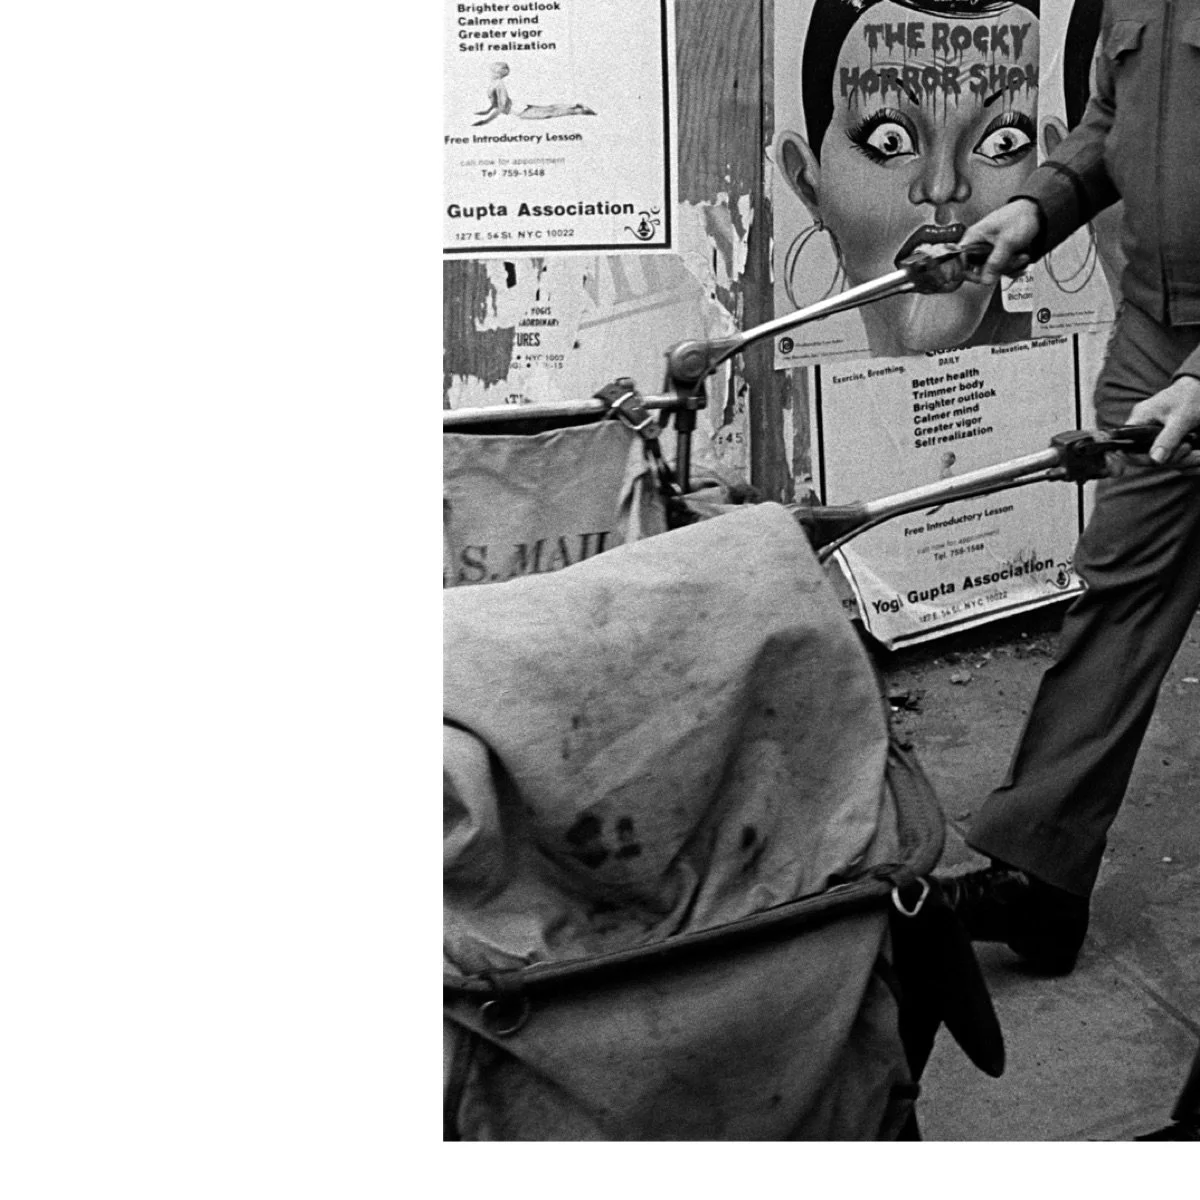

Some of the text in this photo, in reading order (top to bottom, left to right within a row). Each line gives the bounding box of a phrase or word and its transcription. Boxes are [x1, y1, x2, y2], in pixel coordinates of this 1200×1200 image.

[457, 1, 561, 14] Brighter outlook
[458, 15, 539, 26] Calmer mind
[458, 28, 543, 39] Greater vigor
[864, 22, 1032, 60] THE ROCKY
[459, 41, 556, 52] Self realization
[840, 65, 960, 98] HORROR
[444, 133, 583, 144] Free Introductory Lesson
[501, 169, 545, 178] 759-1548
[446, 201, 635, 220] Gupta Association
[518, 230, 543, 239] NYC
[546, 229, 575, 237] 10022
[938, 356, 960, 366] DAILY
[832, 371, 866, 384] Exercise,
[912, 367, 980, 388] Better health
[912, 378, 984, 400] Trimmer body
[913, 388, 997, 413] Brighter outlook
[913, 403, 980, 425] Calmer mind
[914, 415, 983, 438] Greater vigor
[914, 425, 994, 449] Self realization
[904, 504, 1014, 537] Free Introductory Lesson
[872, 594, 904, 615] Yogi
[907, 582, 955, 605] Gupta
[962, 558, 1054, 591] Association
